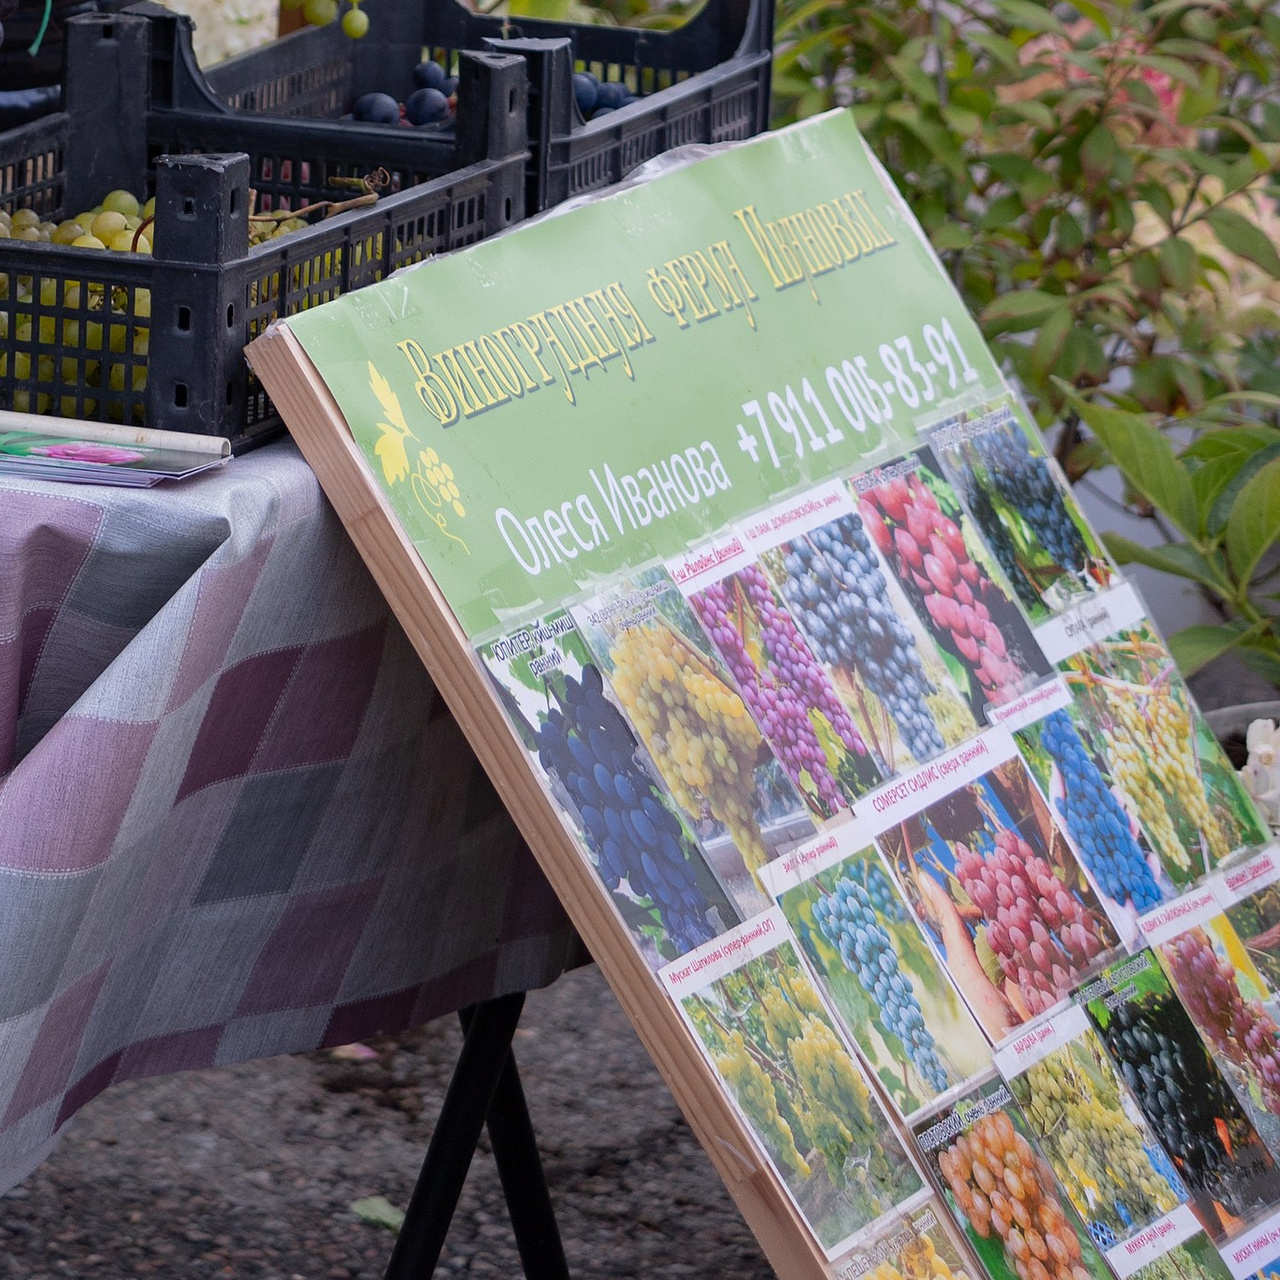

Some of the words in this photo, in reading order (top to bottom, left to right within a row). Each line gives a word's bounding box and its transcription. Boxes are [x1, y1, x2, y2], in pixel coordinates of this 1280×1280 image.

[495, 494, 610, 576] Олеся
[589, 440, 732, 535] Иванова
[737, 398, 781, 468] +7
[766, 377, 844, 459] 911
[825, 316, 978, 432] 005-83-91
[529, 647, 563, 679] ранний
[872, 781, 911, 812] СОМЕРСЕТ
[907, 765, 939, 792] СИДЛИС
[937, 758, 960, 780] (сверх
[959, 737, 989, 767] ранний)
[669, 967, 693, 985] Мускат
[690, 951, 723, 972] Шатилова
[964, 1102, 985, 1123] очень
